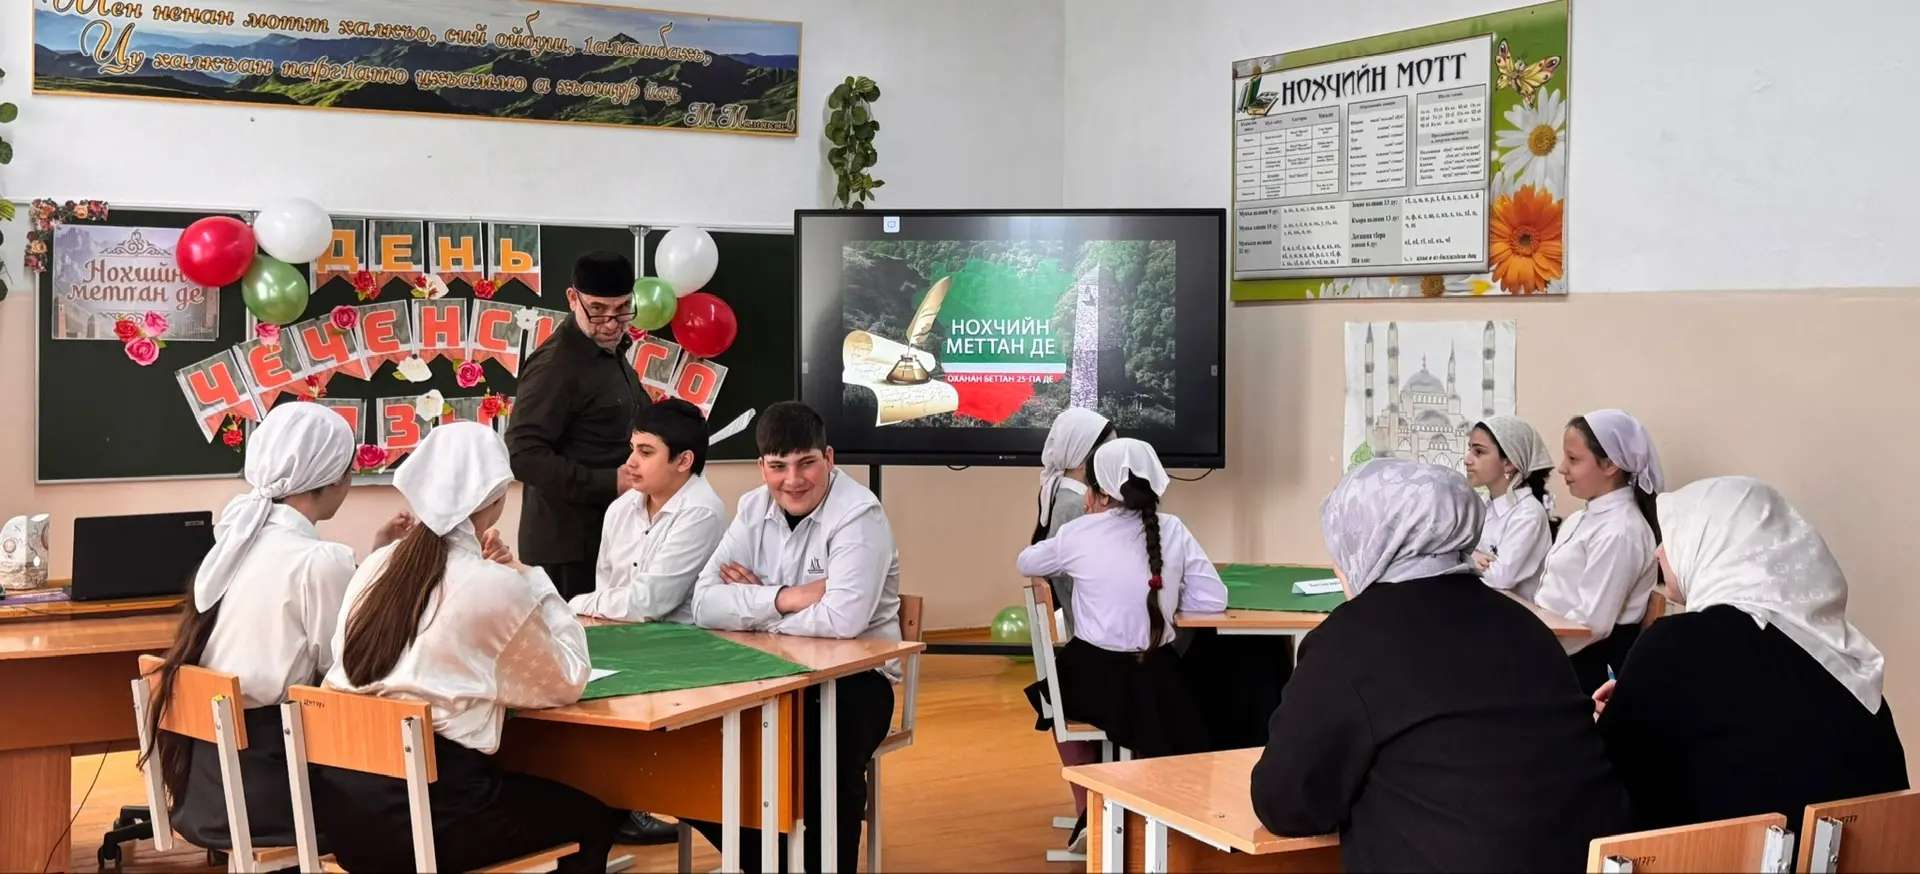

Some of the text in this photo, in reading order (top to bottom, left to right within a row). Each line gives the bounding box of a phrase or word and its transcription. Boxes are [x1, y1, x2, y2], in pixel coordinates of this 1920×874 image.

[153, 5, 235, 27] ненан
[243, 11, 329, 34] мотт
[445, 23, 487, 46] сий
[79, 19, 145, 75] Цу
[152, 51, 273, 77] халкъан
[532, 77, 551, 95] а
[1282, 52, 1467, 106] НОХЧИЙН МОТТ
[317, 230, 534, 274] ДЕНЬ
[175, 285, 205, 311] де
[952, 317, 1049, 335] НОХЧИЙН
[946, 338, 1055, 358] МЕТТАН ДЕ
[947, 375, 982, 383] ОХАНАН
[984, 375, 1015, 383] БЕТТАН
[1043, 375, 1055, 385] ДЕ
